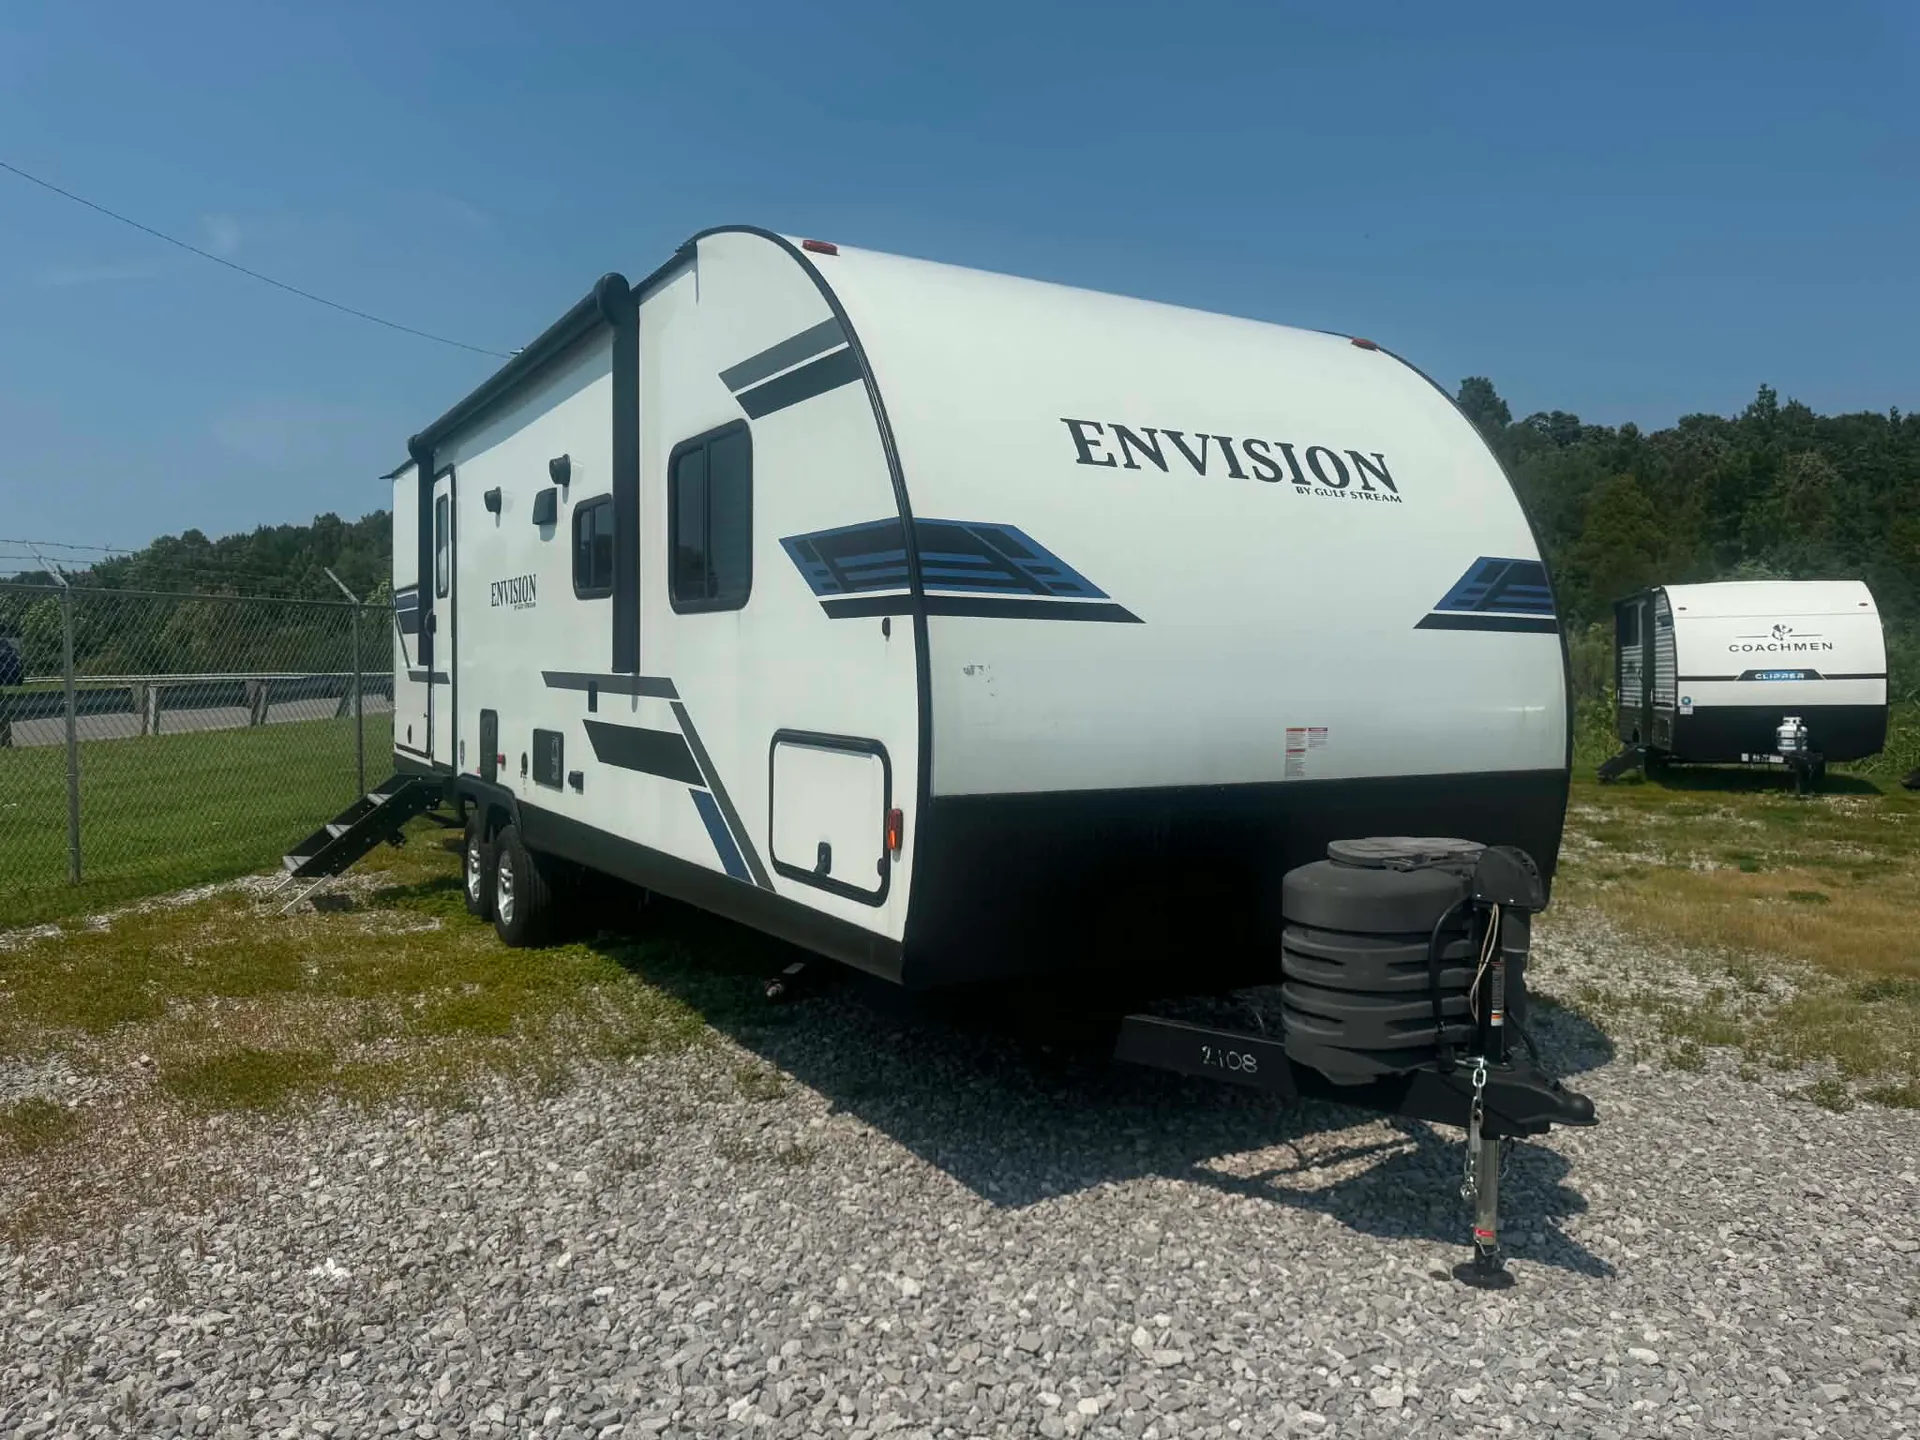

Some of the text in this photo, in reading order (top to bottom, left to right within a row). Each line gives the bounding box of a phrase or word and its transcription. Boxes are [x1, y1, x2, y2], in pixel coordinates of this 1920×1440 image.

[1060, 417, 1398, 493] ENVISION
[1295, 486, 1402, 503] BY GULF STREAM
[491, 573, 536, 607] ENVISION
[1728, 642, 1833, 653] COACHMEN
[1754, 672, 1805, 680] CLIPPER
